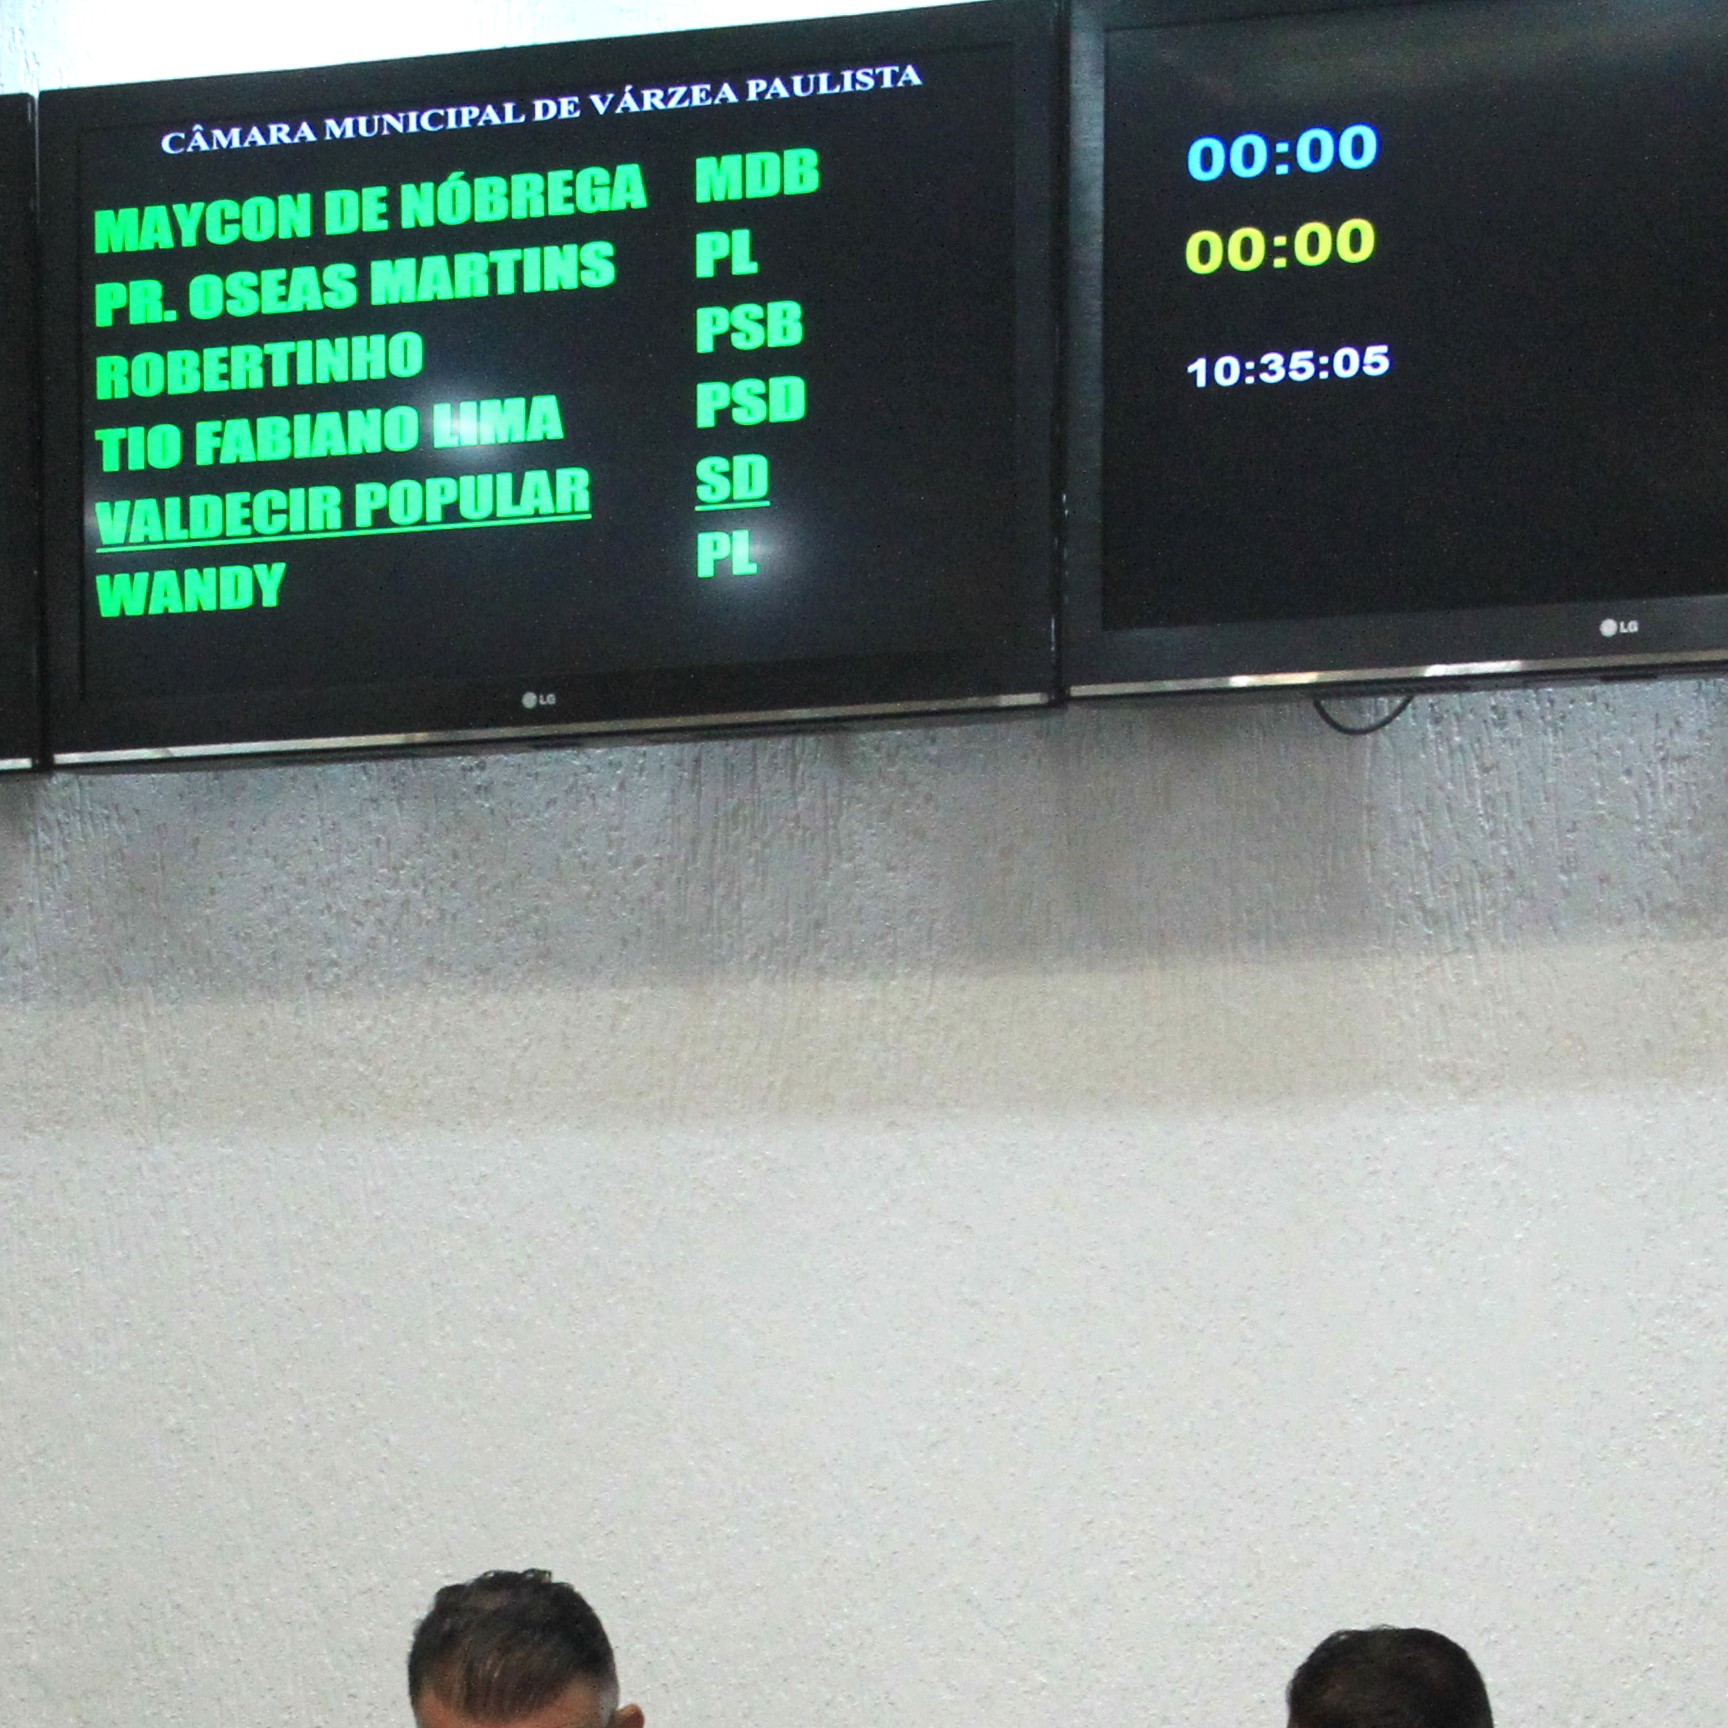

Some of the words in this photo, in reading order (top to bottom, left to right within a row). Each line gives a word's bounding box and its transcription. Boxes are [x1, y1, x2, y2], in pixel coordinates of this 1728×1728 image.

[160, 121, 318, 155] CÂMARA
[324, 102, 526, 141] MUNICIPAL
[532, 96, 581, 122] DE
[588, 82, 739, 116] VÁRZEA
[746, 64, 923, 102] PAULISTA
[695, 147, 821, 204] MDB
[1187, 121, 1381, 182] 00:00
[94, 192, 312, 254] MAYCON
[324, 185, 390, 236] DE
[400, 163, 649, 229] NÓBREGA
[695, 228, 759, 279] PL
[1185, 218, 1376, 275] 00:00
[94, 279, 178, 328] PR.
[188, 262, 359, 320] OSEAS
[370, 240, 617, 306] MARTINS
[696, 300, 804, 354] PSB
[95, 330, 424, 401] ROBERTINHO
[1187, 344, 1390, 388] 10:35:05
[696, 375, 807, 429] PSD
[94, 423, 183, 473] TIO
[195, 405, 423, 466] FABIANO
[429, 394, 565, 450] LIMA
[95, 484, 341, 545] VALDECIR
[354, 466, 592, 529] POPULAR
[694, 453, 770, 504] SD
[696, 527, 760, 579] PL
[95, 561, 287, 618] WANDY
